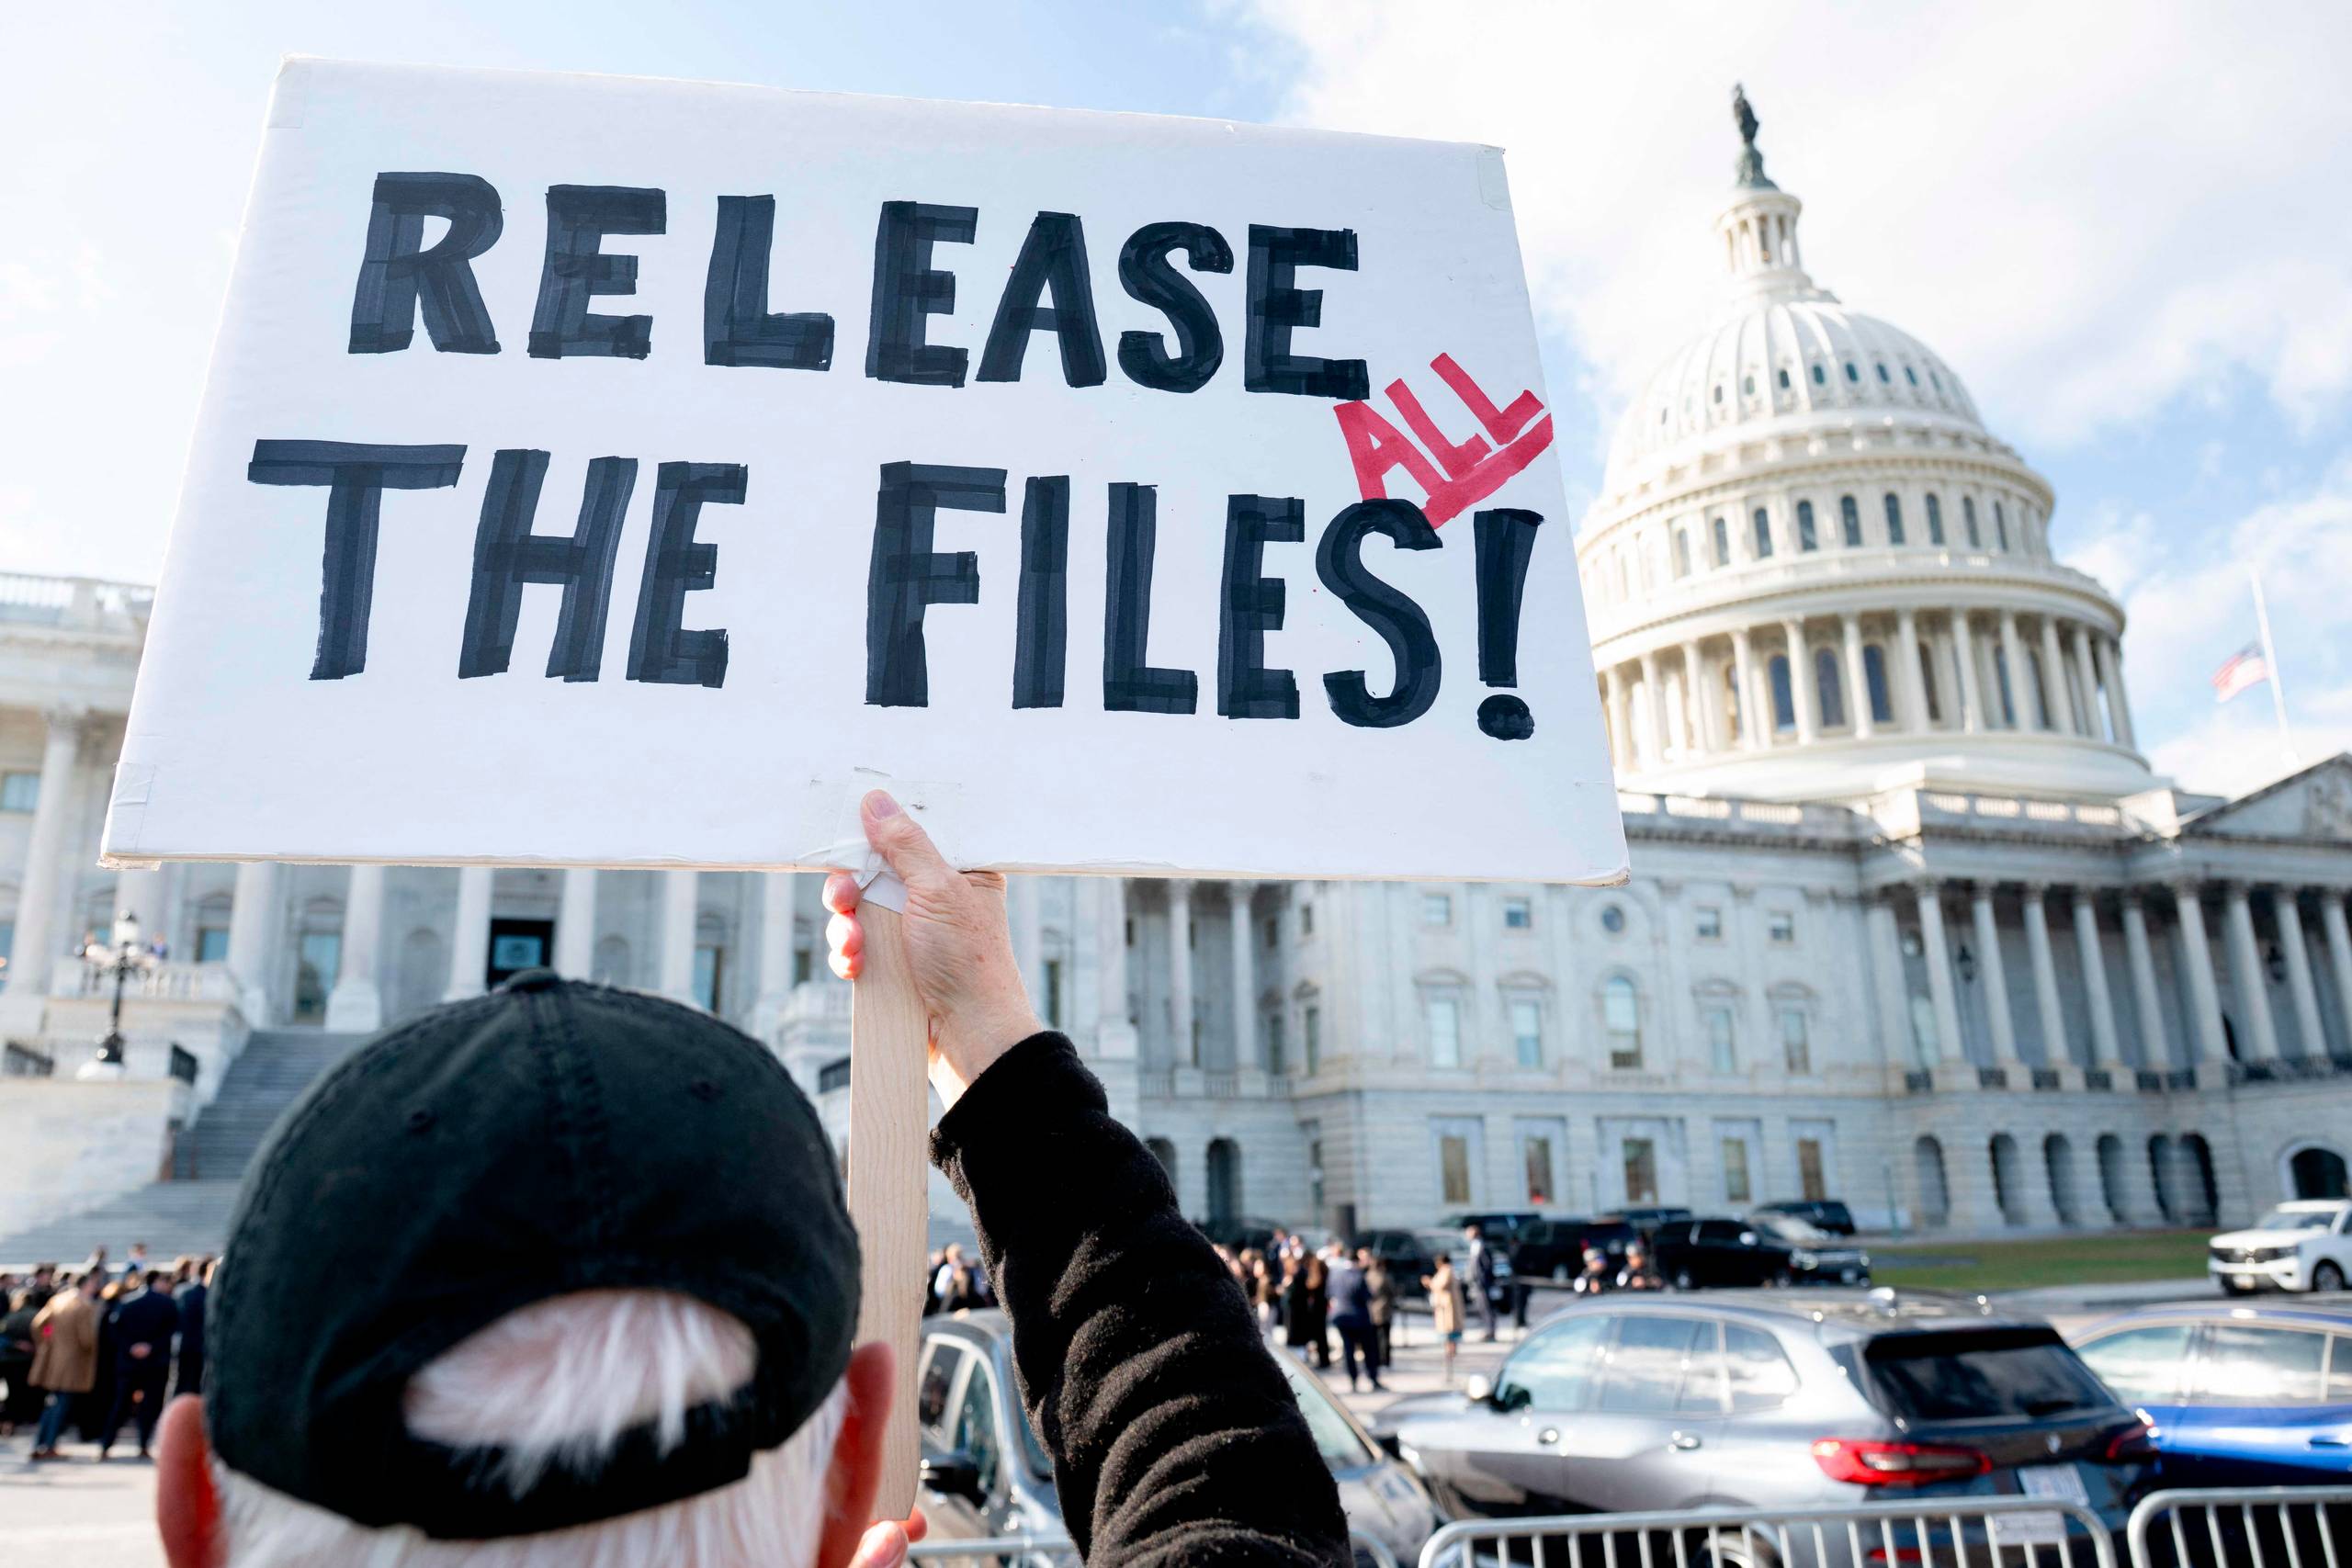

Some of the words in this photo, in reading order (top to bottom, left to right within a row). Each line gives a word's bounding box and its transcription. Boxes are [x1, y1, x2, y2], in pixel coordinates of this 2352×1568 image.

[348, 172, 1370, 401] RELEASE
[1334, 353, 1547, 503] ALL
[248, 439, 748, 689] THE
[865, 461, 1544, 741] FILES!
